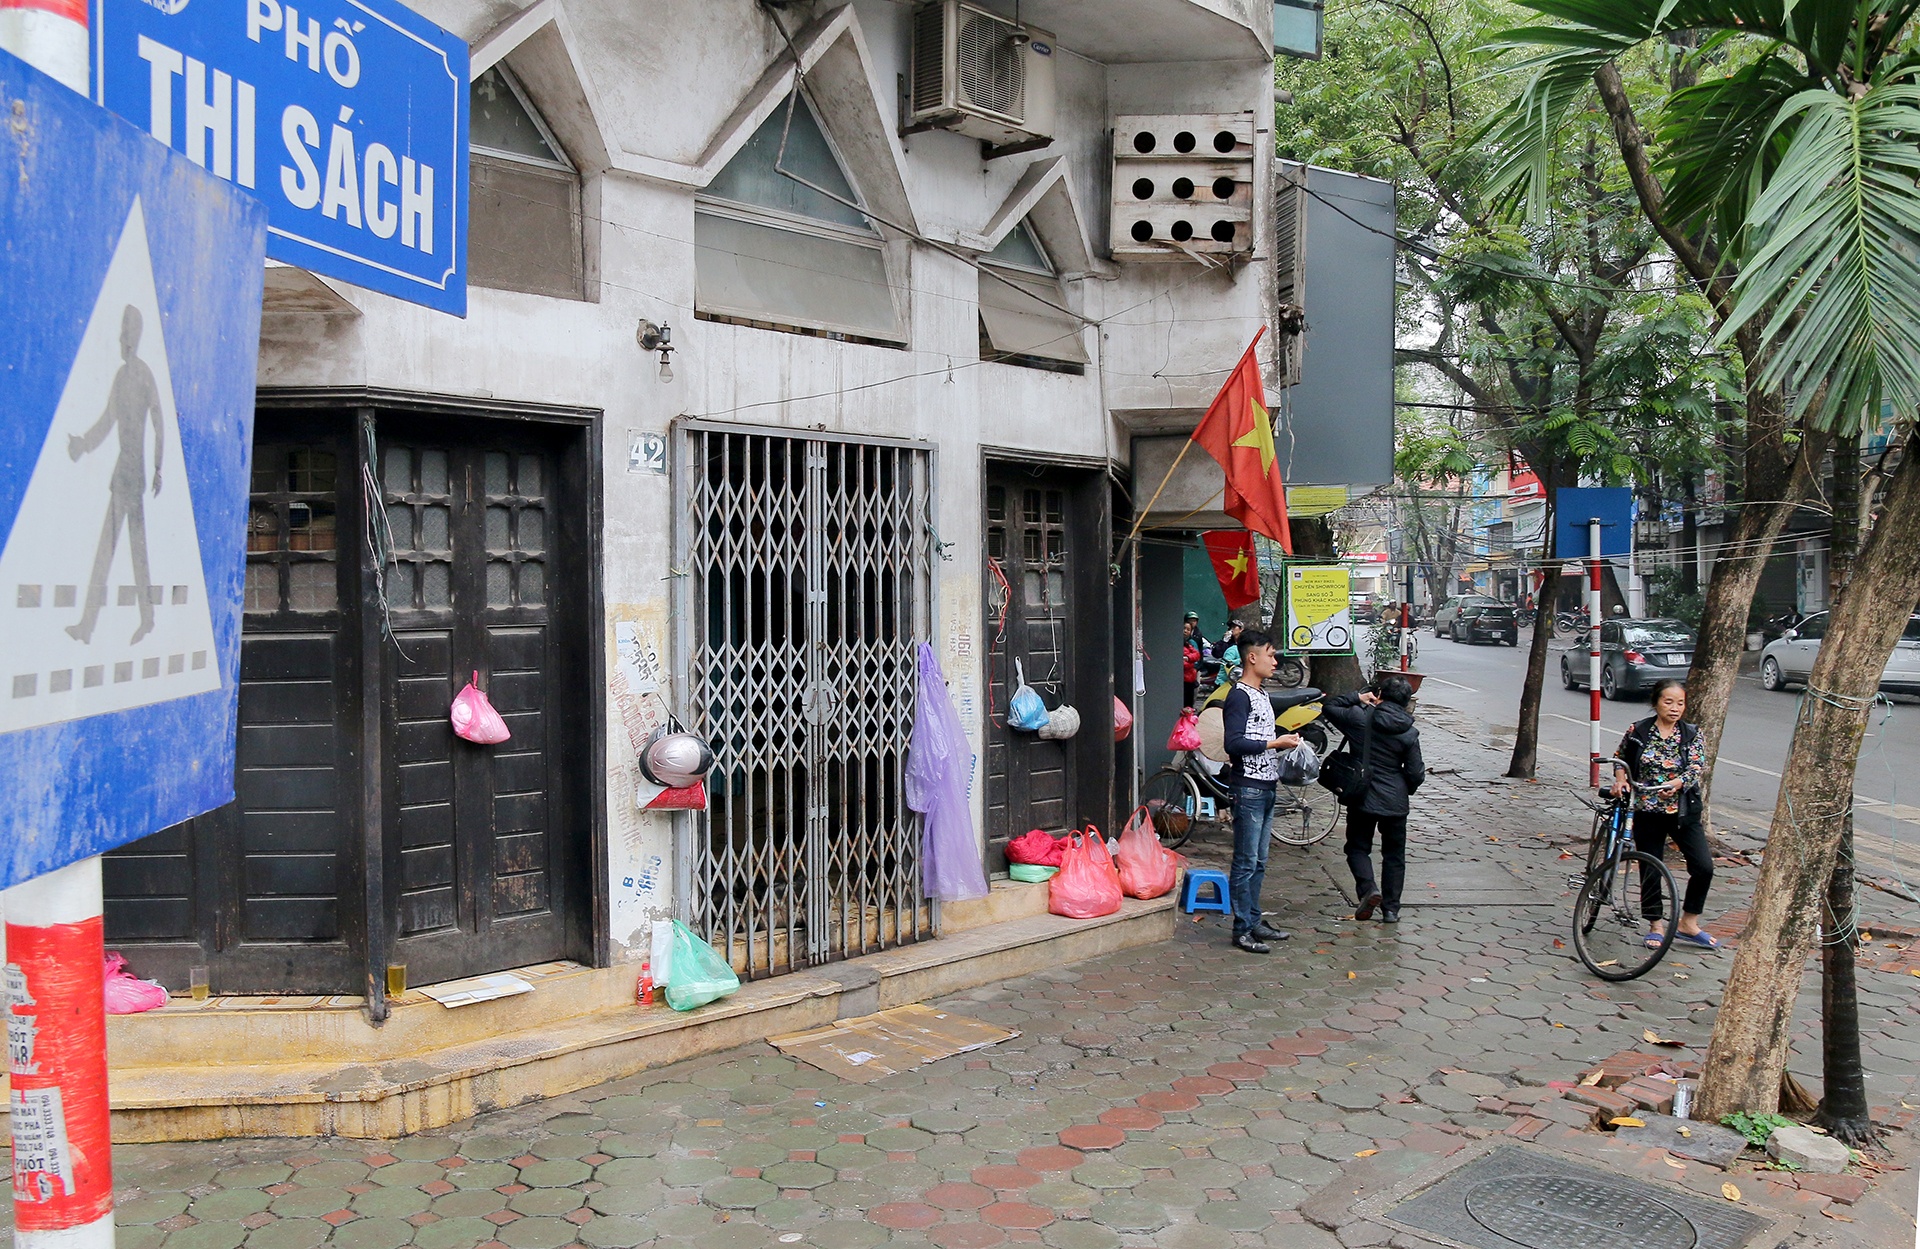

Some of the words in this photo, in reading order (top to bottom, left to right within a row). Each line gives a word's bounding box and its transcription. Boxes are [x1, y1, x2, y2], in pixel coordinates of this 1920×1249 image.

[247, 0, 365, 89] PHỐ
[138, 34, 255, 190] THI
[281, 105, 434, 254] SÁCH
[631, 436, 665, 469] 42
